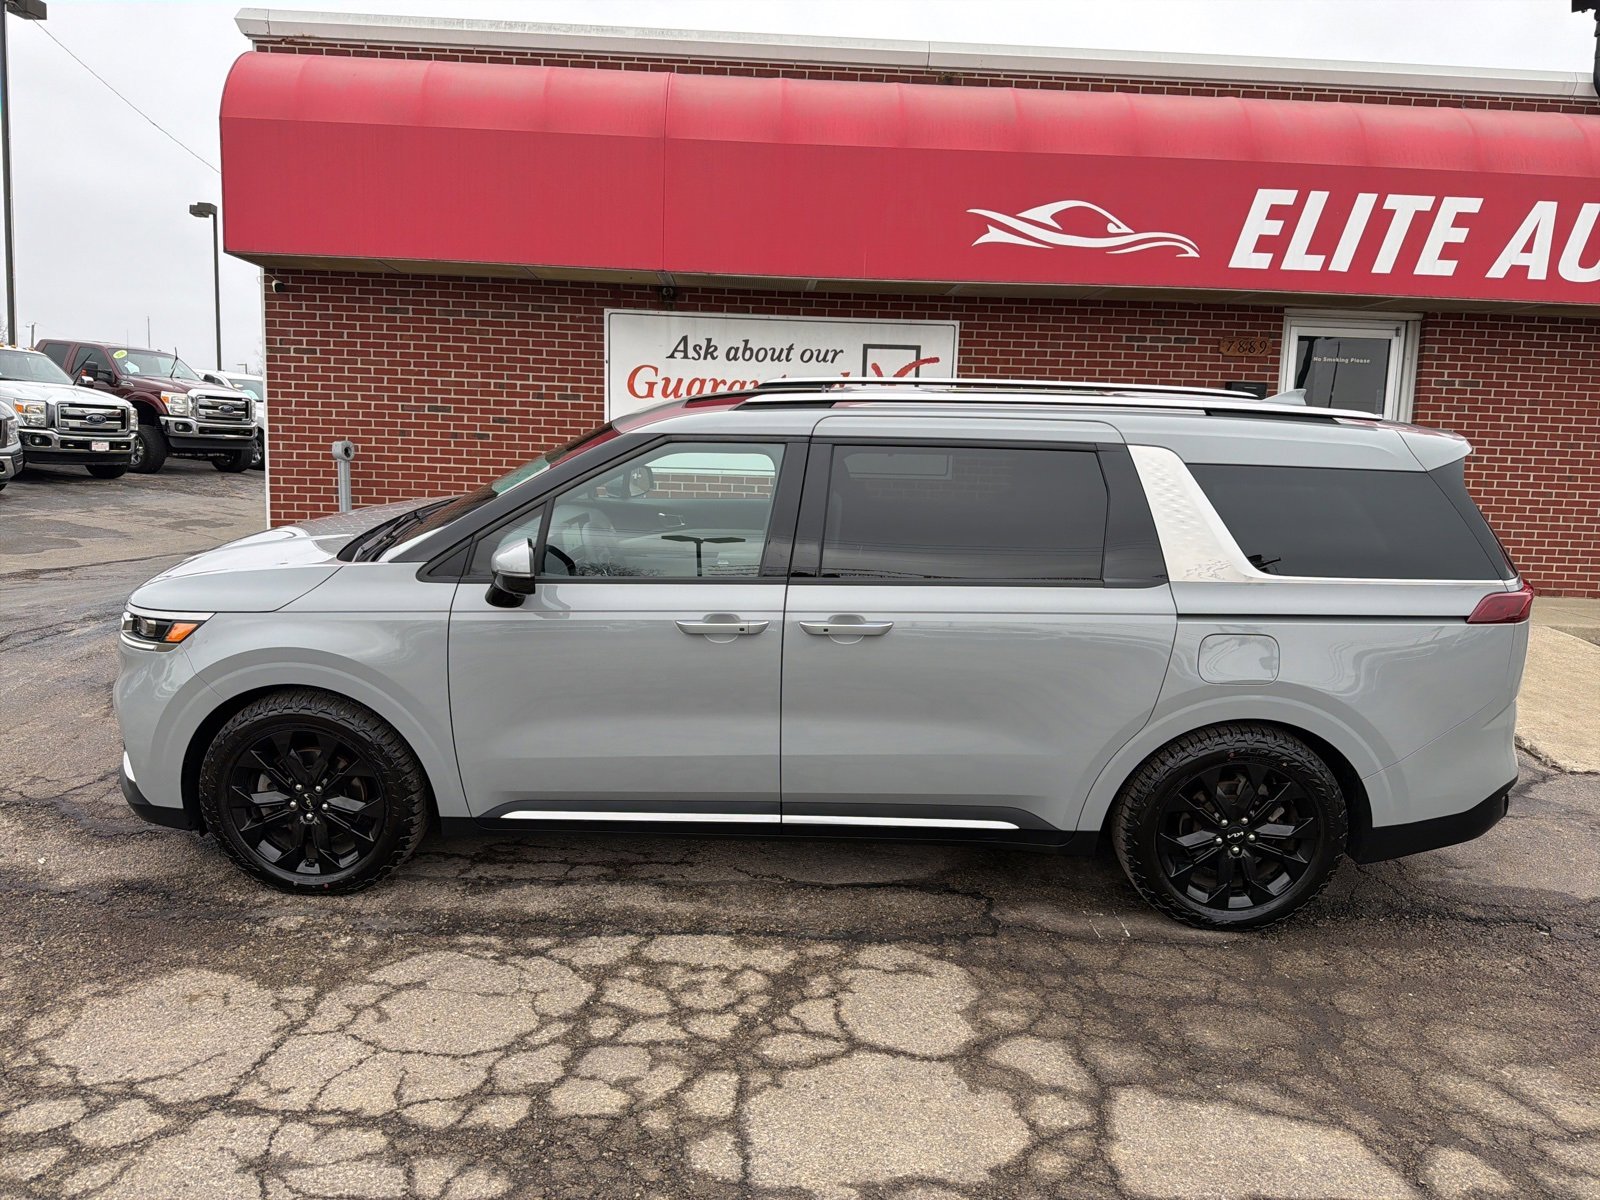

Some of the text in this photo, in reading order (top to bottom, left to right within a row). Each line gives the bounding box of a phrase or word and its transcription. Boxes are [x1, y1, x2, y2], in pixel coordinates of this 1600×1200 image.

[1228, 188, 1484, 277] ELITE
[665, 334, 845, 364] Ask about our
[1226, 340, 1268, 354] 7889
[1323, 356, 1349, 364] Smoking
